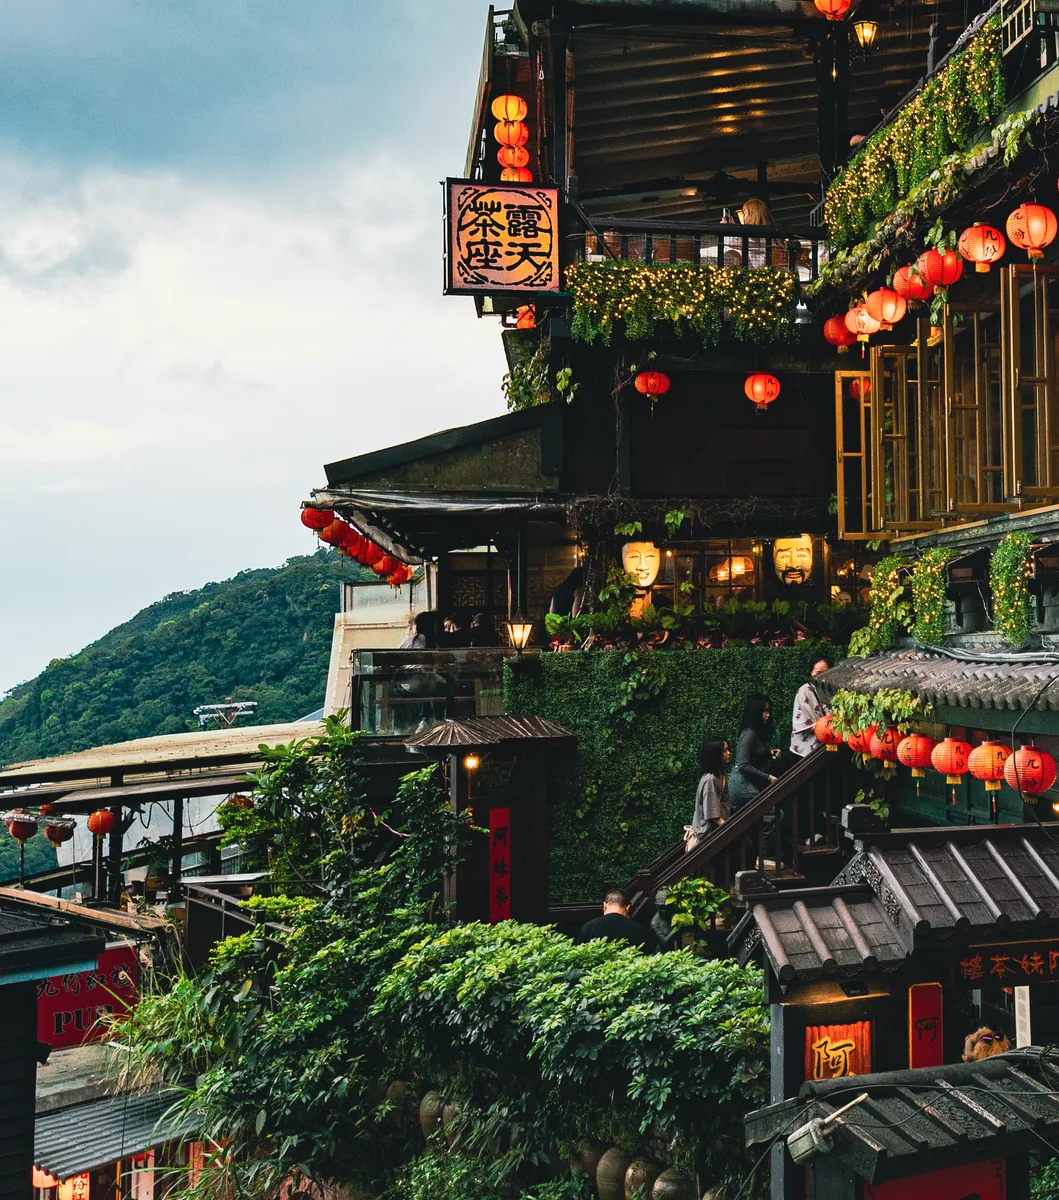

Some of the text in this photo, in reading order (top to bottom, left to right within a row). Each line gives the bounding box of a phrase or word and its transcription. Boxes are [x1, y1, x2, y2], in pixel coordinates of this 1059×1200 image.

[985, 230, 998, 257] 九份
[1025, 759, 1040, 788] 九份
[492, 826, 509, 911] 阿妹茶
[914, 1017, 940, 1042] 阿
